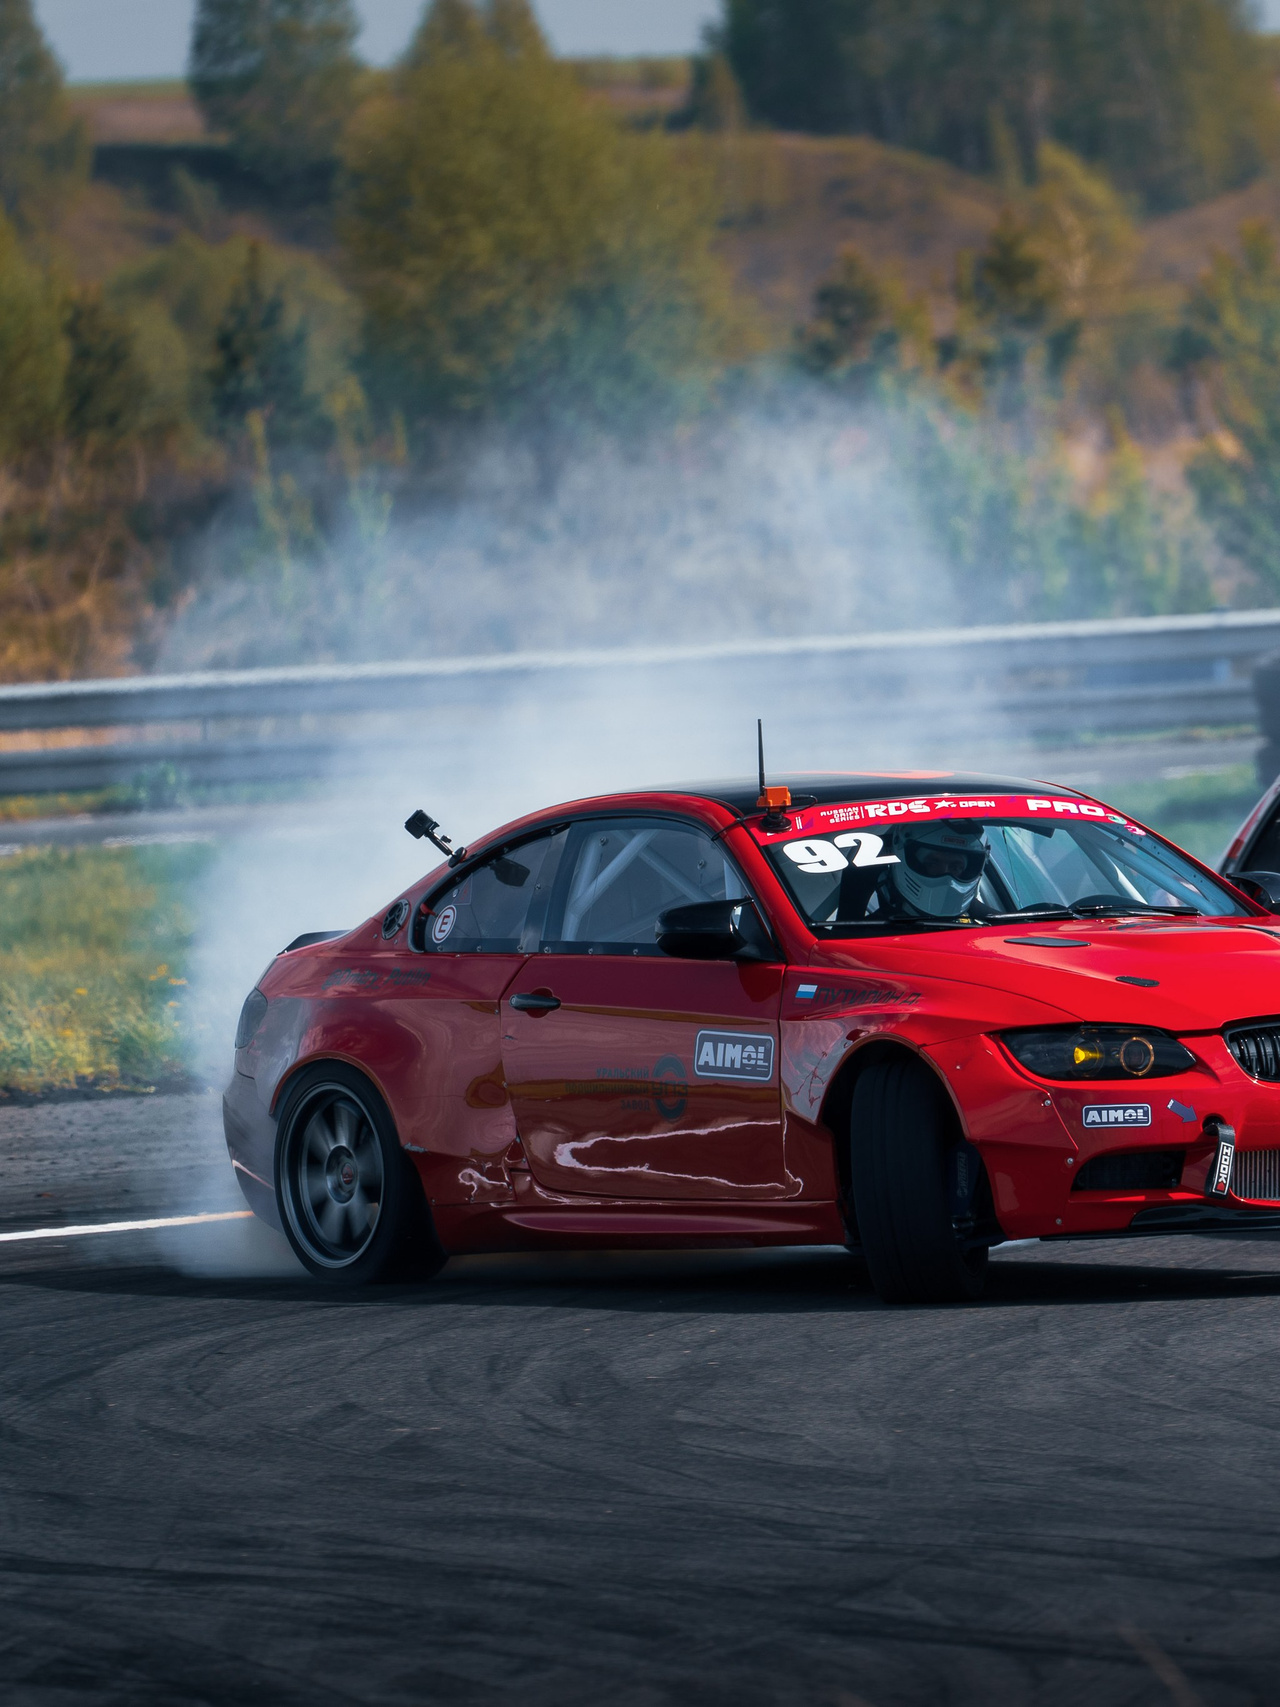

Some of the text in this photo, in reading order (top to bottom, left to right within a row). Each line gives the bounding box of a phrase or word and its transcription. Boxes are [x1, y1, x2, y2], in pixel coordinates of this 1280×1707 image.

[820, 806, 859, 816] RUSSIAN
[864, 800, 931, 818] RDS
[1026, 798, 1106, 817] PRO
[829, 814, 860, 824] SERIES
[782, 831, 901, 874] 92
[438, 914, 451, 933] E
[815, 987, 904, 1004] ПУТИЛИН
[697, 1041, 769, 1071] AIMOL
[596, 1066, 649, 1078] УРАЛЬСКИЙ
[620, 1099, 651, 1111] ЗАВОД
[1086, 1109, 1148, 1123] AIMOL
[1218, 1146, 1232, 1184] HOOK
